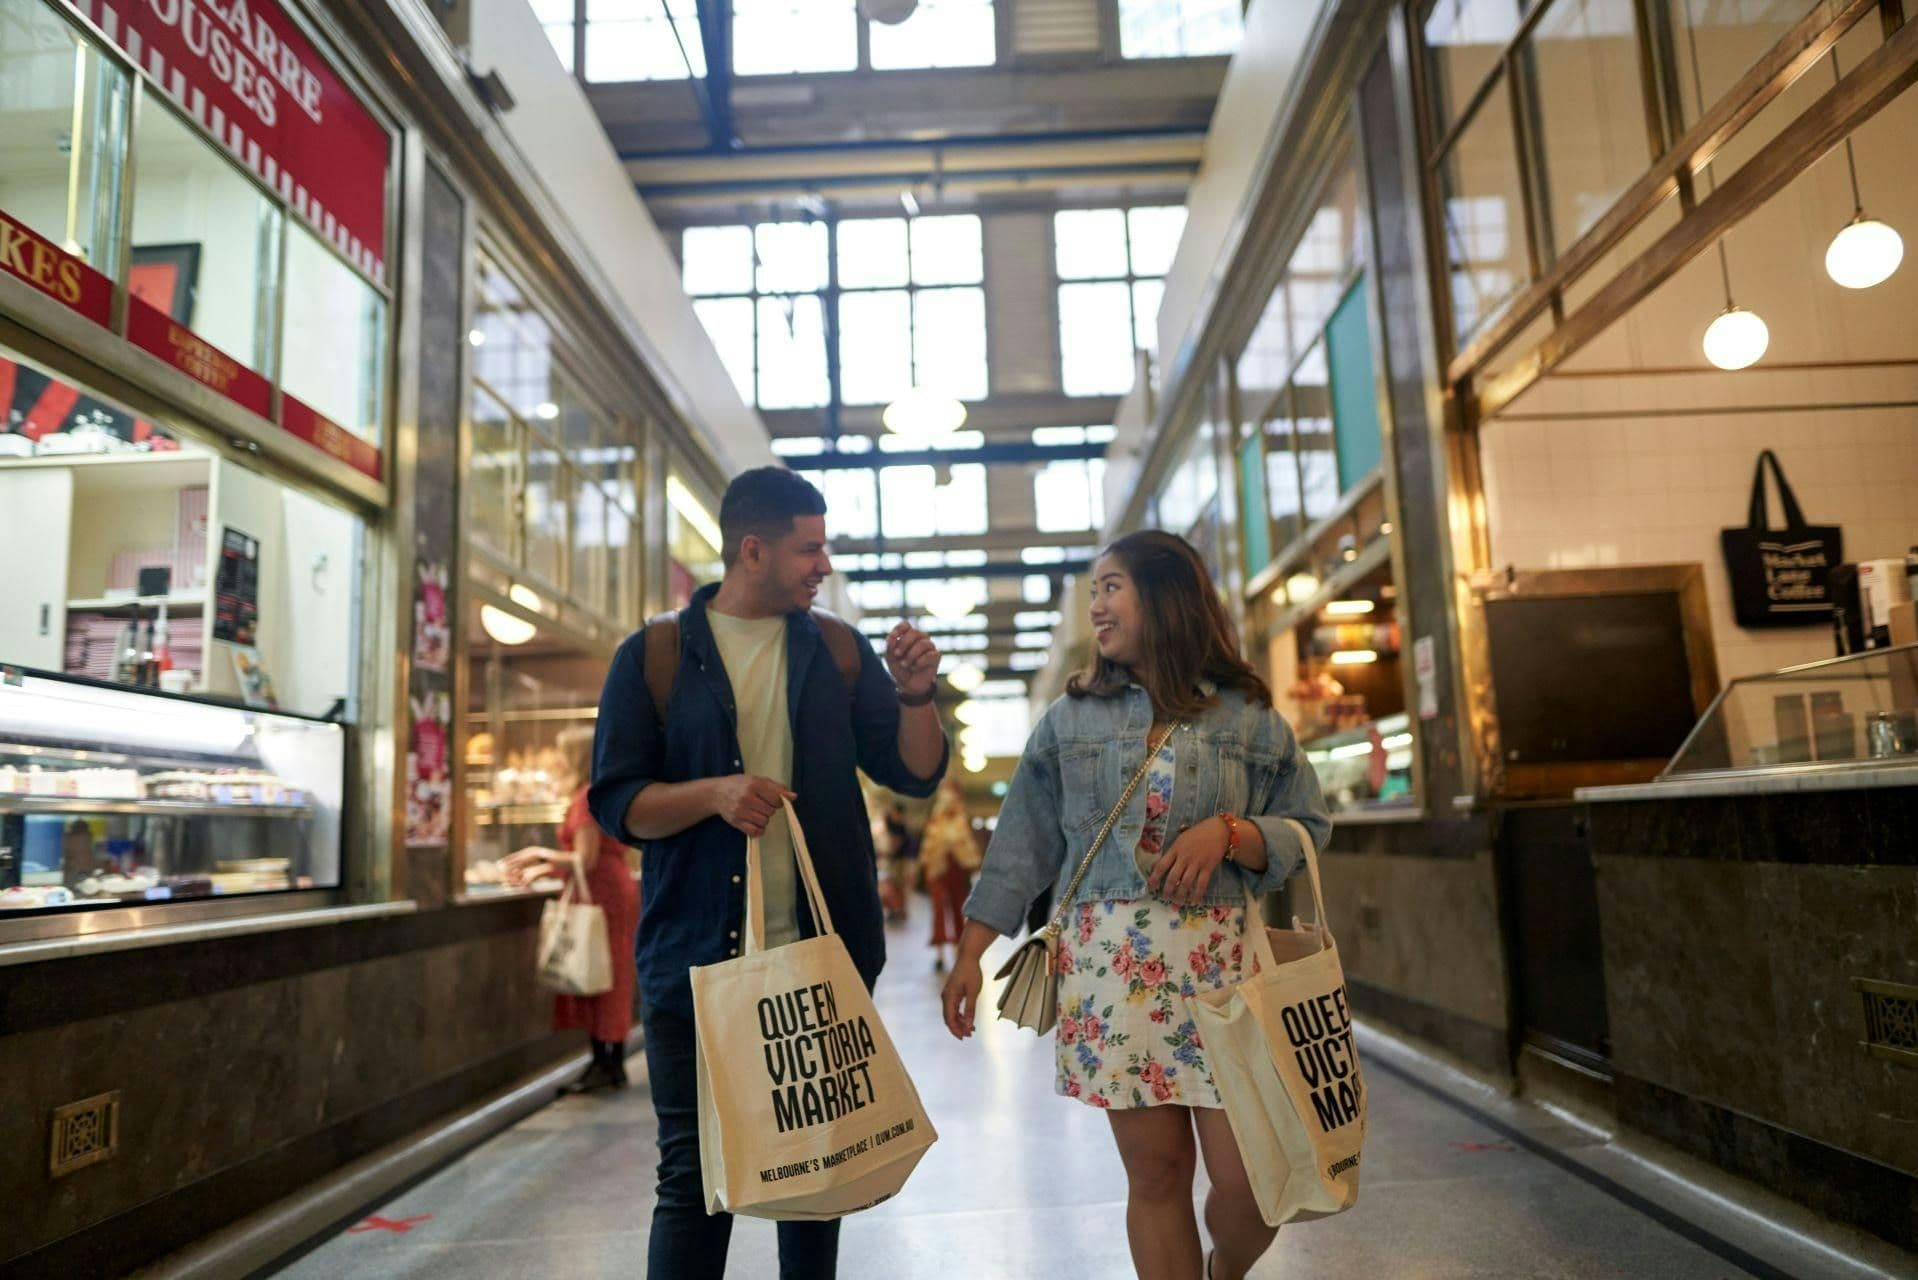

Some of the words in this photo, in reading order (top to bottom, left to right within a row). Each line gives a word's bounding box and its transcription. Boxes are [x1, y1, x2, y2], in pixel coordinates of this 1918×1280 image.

[206, 0, 323, 124] ARRE
[757, 979, 838, 1041] QUEEN
[1281, 984, 1350, 1048] QUEE
[763, 1015, 876, 1086] VICTORIA
[1294, 1031, 1359, 1089] VICT
[771, 1061, 875, 1133] MARKET
[760, 1158, 820, 1183] MELBOURNE'S
[822, 1138, 868, 1170] MARKETPLACE
